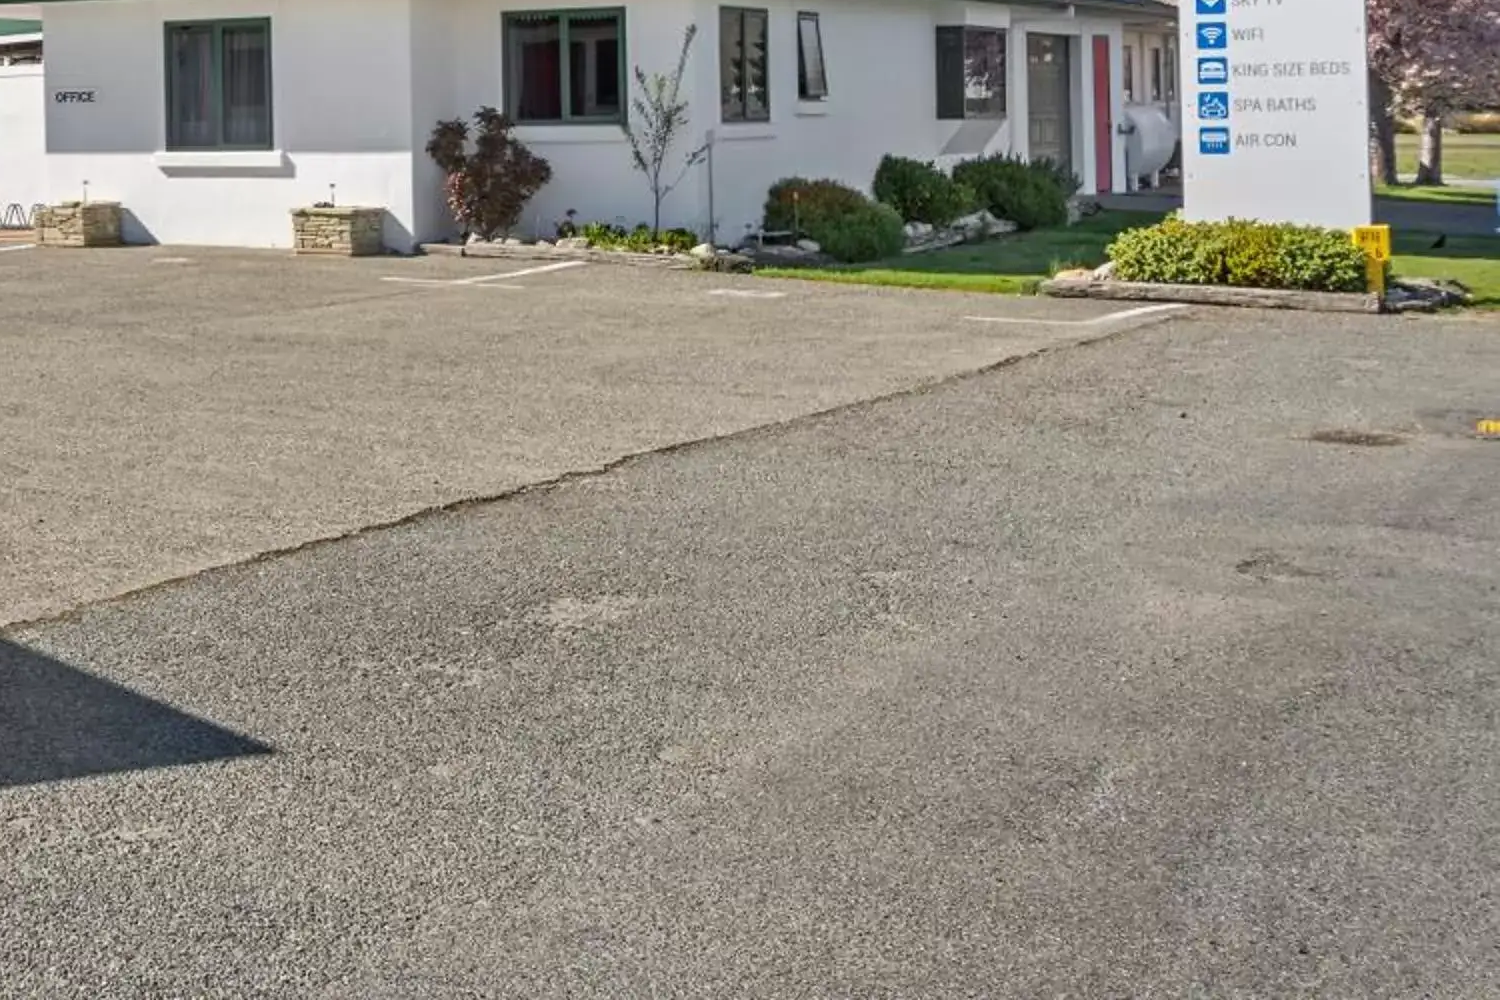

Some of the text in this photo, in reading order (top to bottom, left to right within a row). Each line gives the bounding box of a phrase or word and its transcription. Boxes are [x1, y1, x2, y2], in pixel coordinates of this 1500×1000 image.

[1232, 27, 1264, 41] WIFI
[1232, 61, 1351, 77] KING SIZE BEDS
[55, 91, 97, 103] OFFICE
[1234, 96, 1317, 112] SPA BATHS
[1235, 133, 1297, 147] AIR CON
